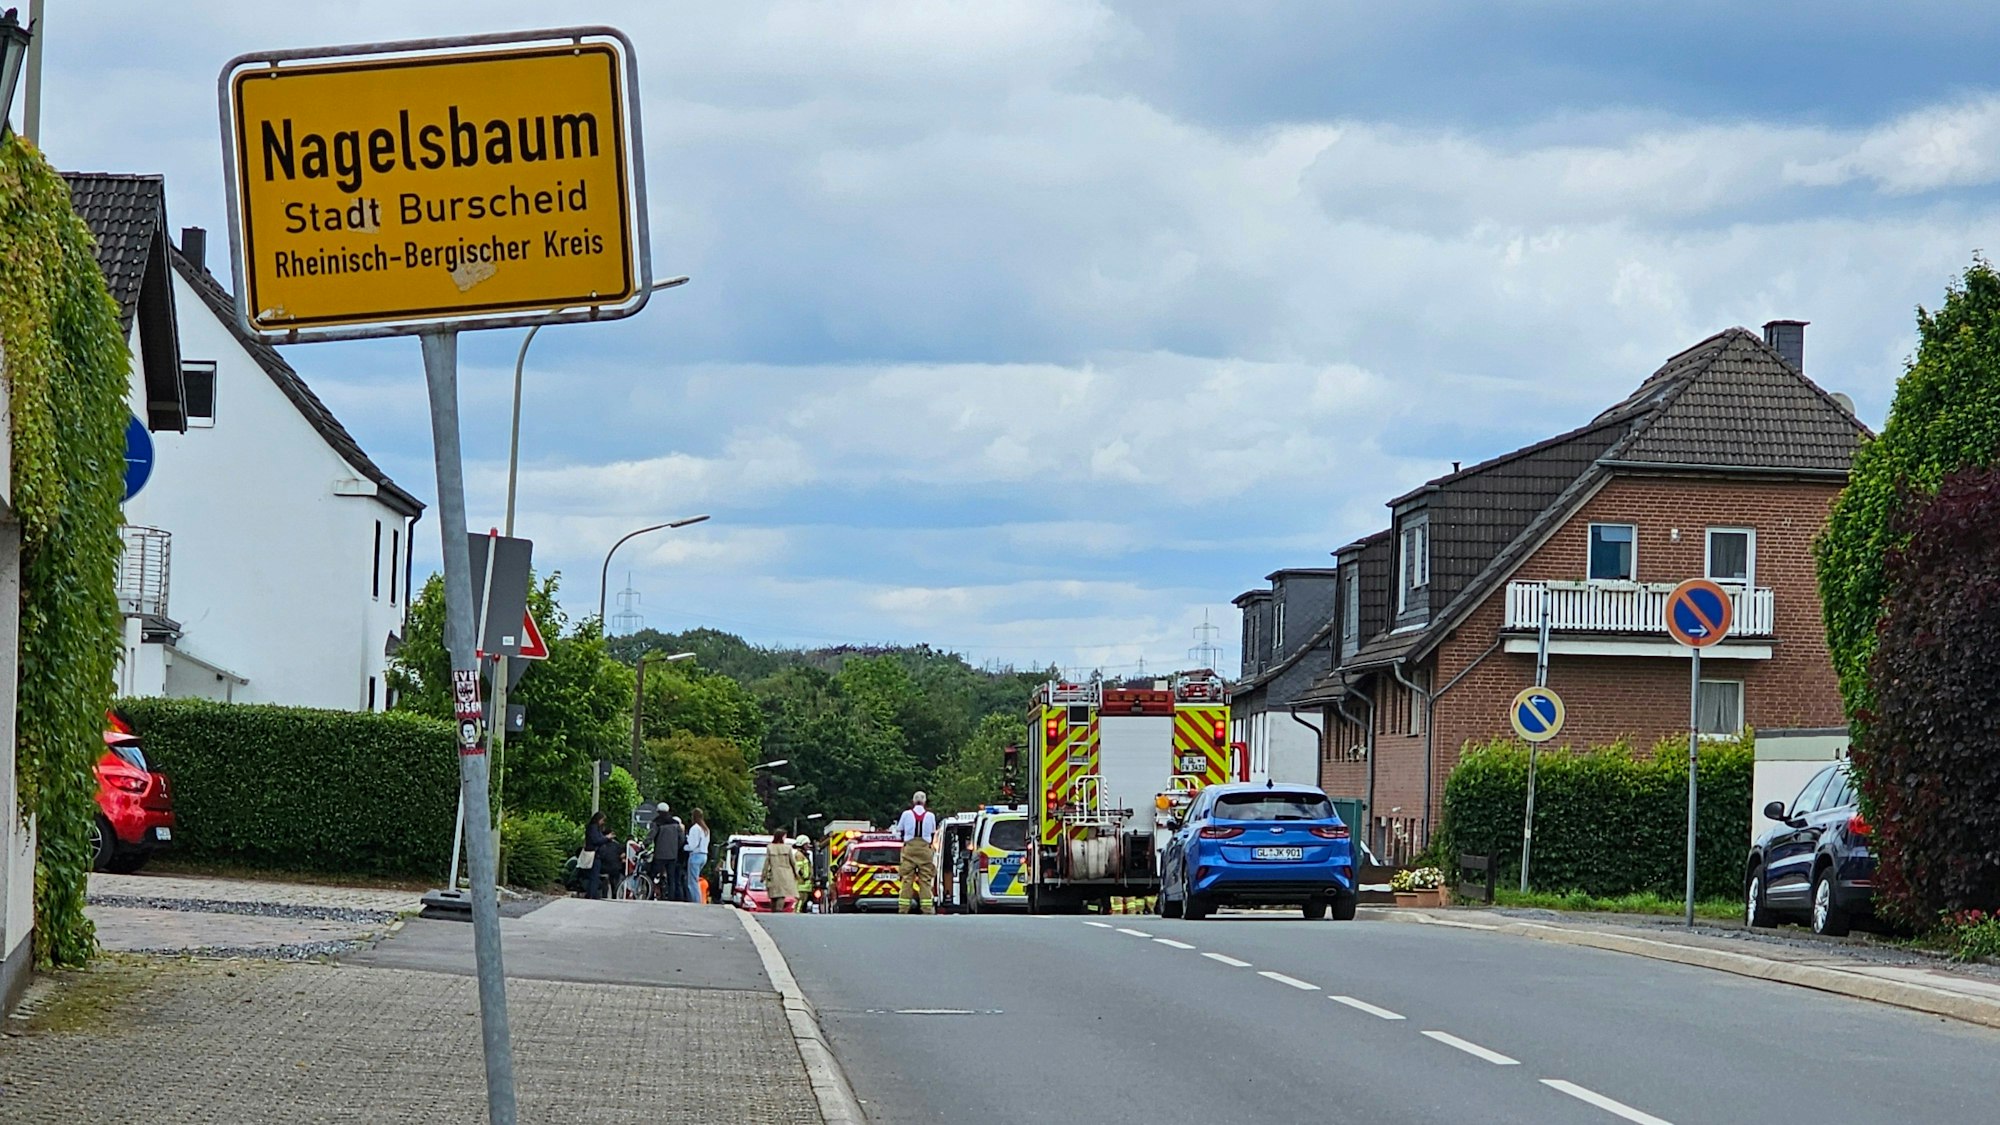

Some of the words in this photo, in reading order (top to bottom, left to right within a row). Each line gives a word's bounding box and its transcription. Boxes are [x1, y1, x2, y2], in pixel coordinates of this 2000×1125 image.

[261, 105, 600, 194] Nagelsbaum
[284, 198, 381, 234] Stadt
[399, 179, 588, 225] Burscheid
[274, 235, 532, 279] Rheinisch-Bergischer
[543, 228, 604, 259] Kreis
[988, 857, 1022, 865] POLIZE
[1257, 848, 1268, 857] GL
[1286, 848, 1301, 857] 901
